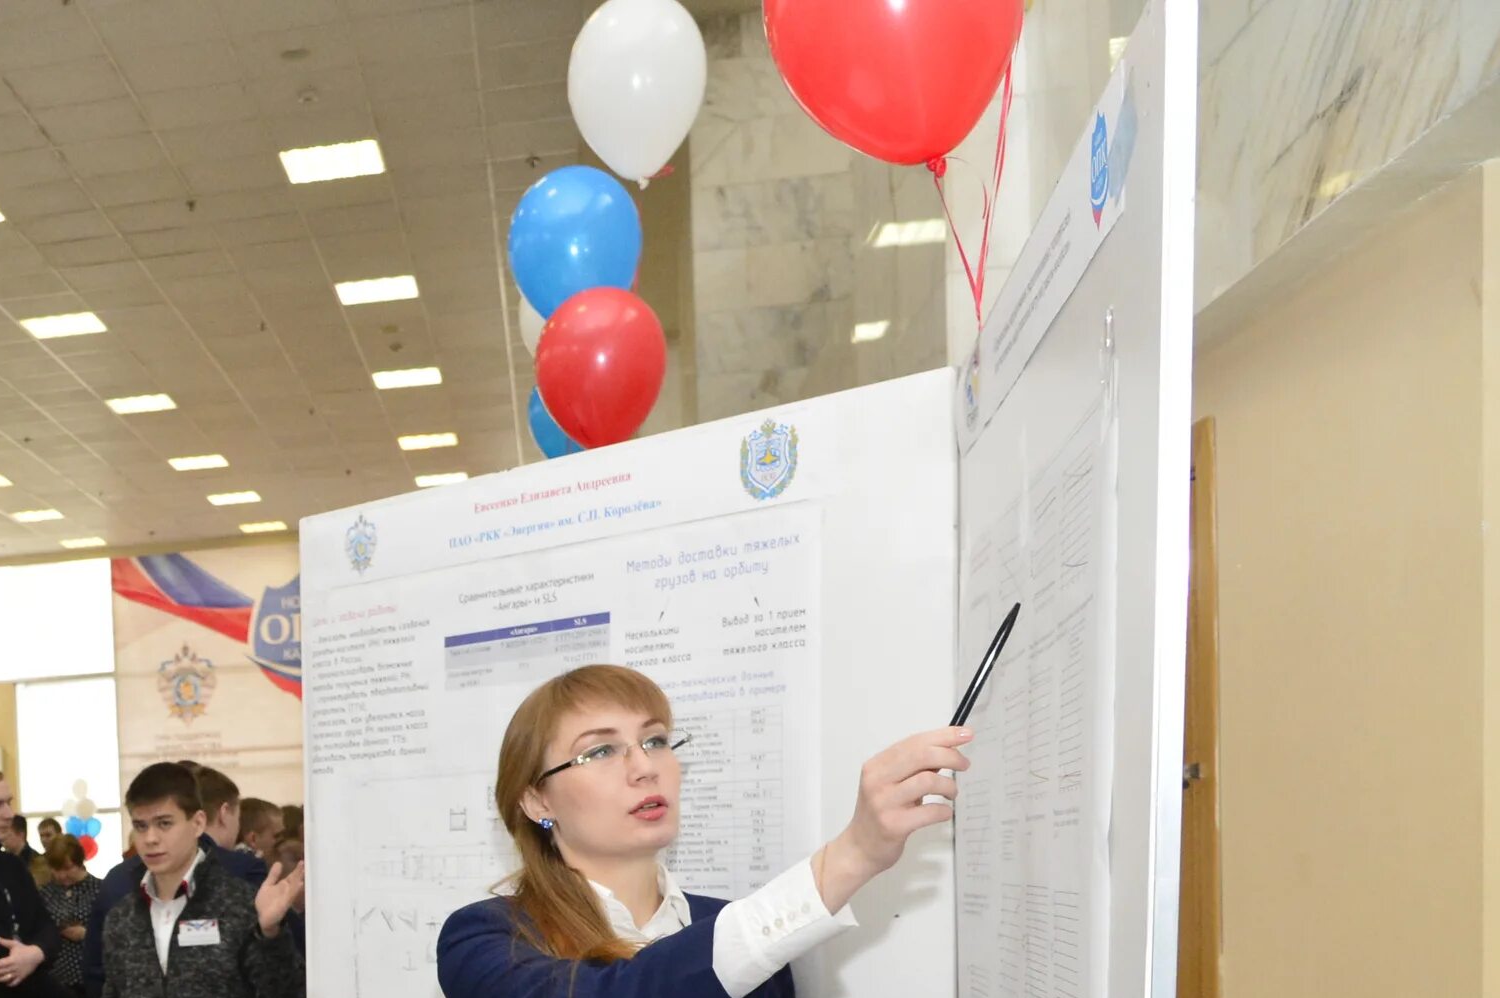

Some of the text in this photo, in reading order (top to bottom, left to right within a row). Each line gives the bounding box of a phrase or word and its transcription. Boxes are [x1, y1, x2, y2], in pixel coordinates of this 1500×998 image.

[474, 472, 632, 514] Евсеенко Елизавета Андреевна
[449, 537, 472, 549] ПАО
[474, 528, 502, 544] «РКК
[557, 516, 574, 528] им.
[578, 508, 600, 524] С.П.
[604, 498, 662, 518] Королёва»
[626, 534, 800, 574] Методы доставки тяжелых
[655, 560, 769, 591] грузов на орбиту
[458, 573, 595, 604] Сравнительные характеристики
[534, 596, 541, 605] и
[542, 592, 558, 604] SLS
[722, 613, 750, 628] Вывод
[754, 613, 764, 623] за
[777, 608, 806, 620] прием
[625, 626, 680, 640] Несколькими
[755, 623, 807, 638] носителем
[625, 642, 675, 655] носителями
[723, 639, 806, 656] тяжелого класса
[662, 652, 692, 664] класса
